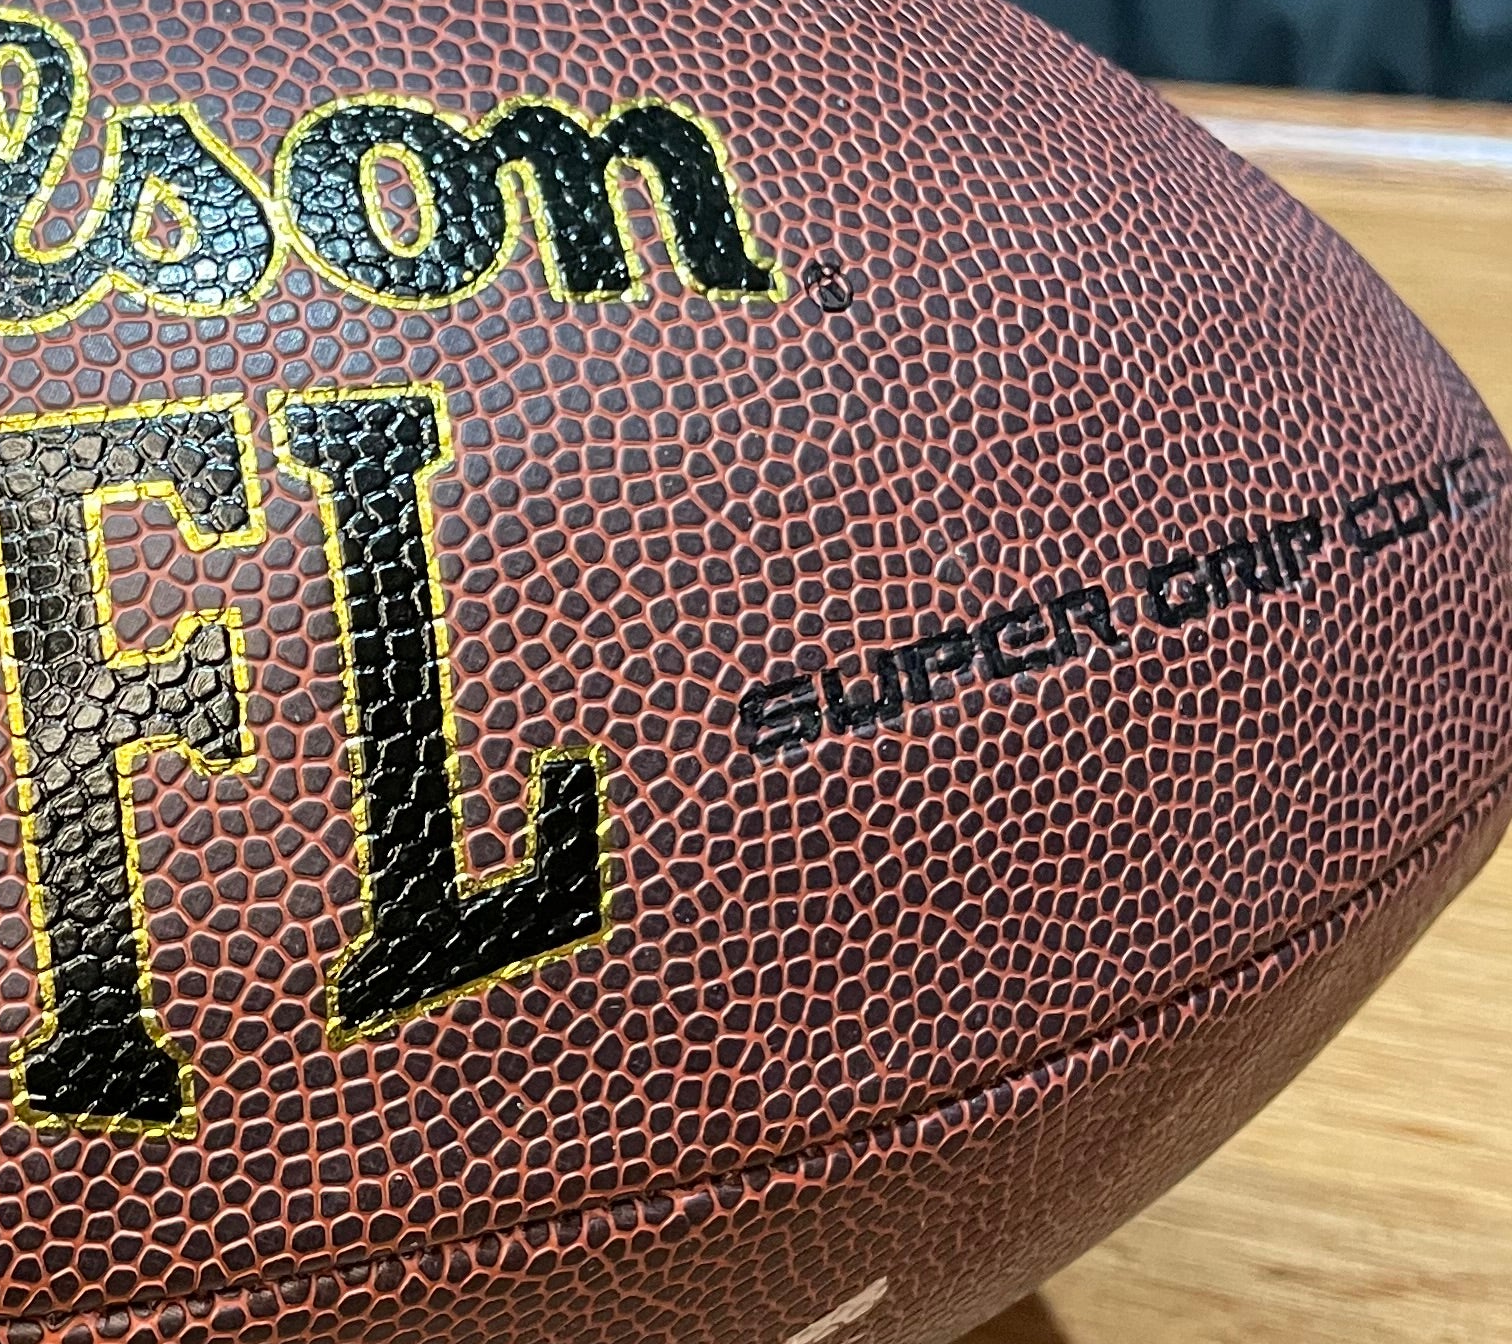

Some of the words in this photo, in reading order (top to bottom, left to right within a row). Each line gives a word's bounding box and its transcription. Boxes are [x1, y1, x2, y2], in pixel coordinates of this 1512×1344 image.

[740, 586, 1126, 758] SUPER
[1146, 516, 1324, 626] GRIP
[1346, 447, 1498, 558] COVE
